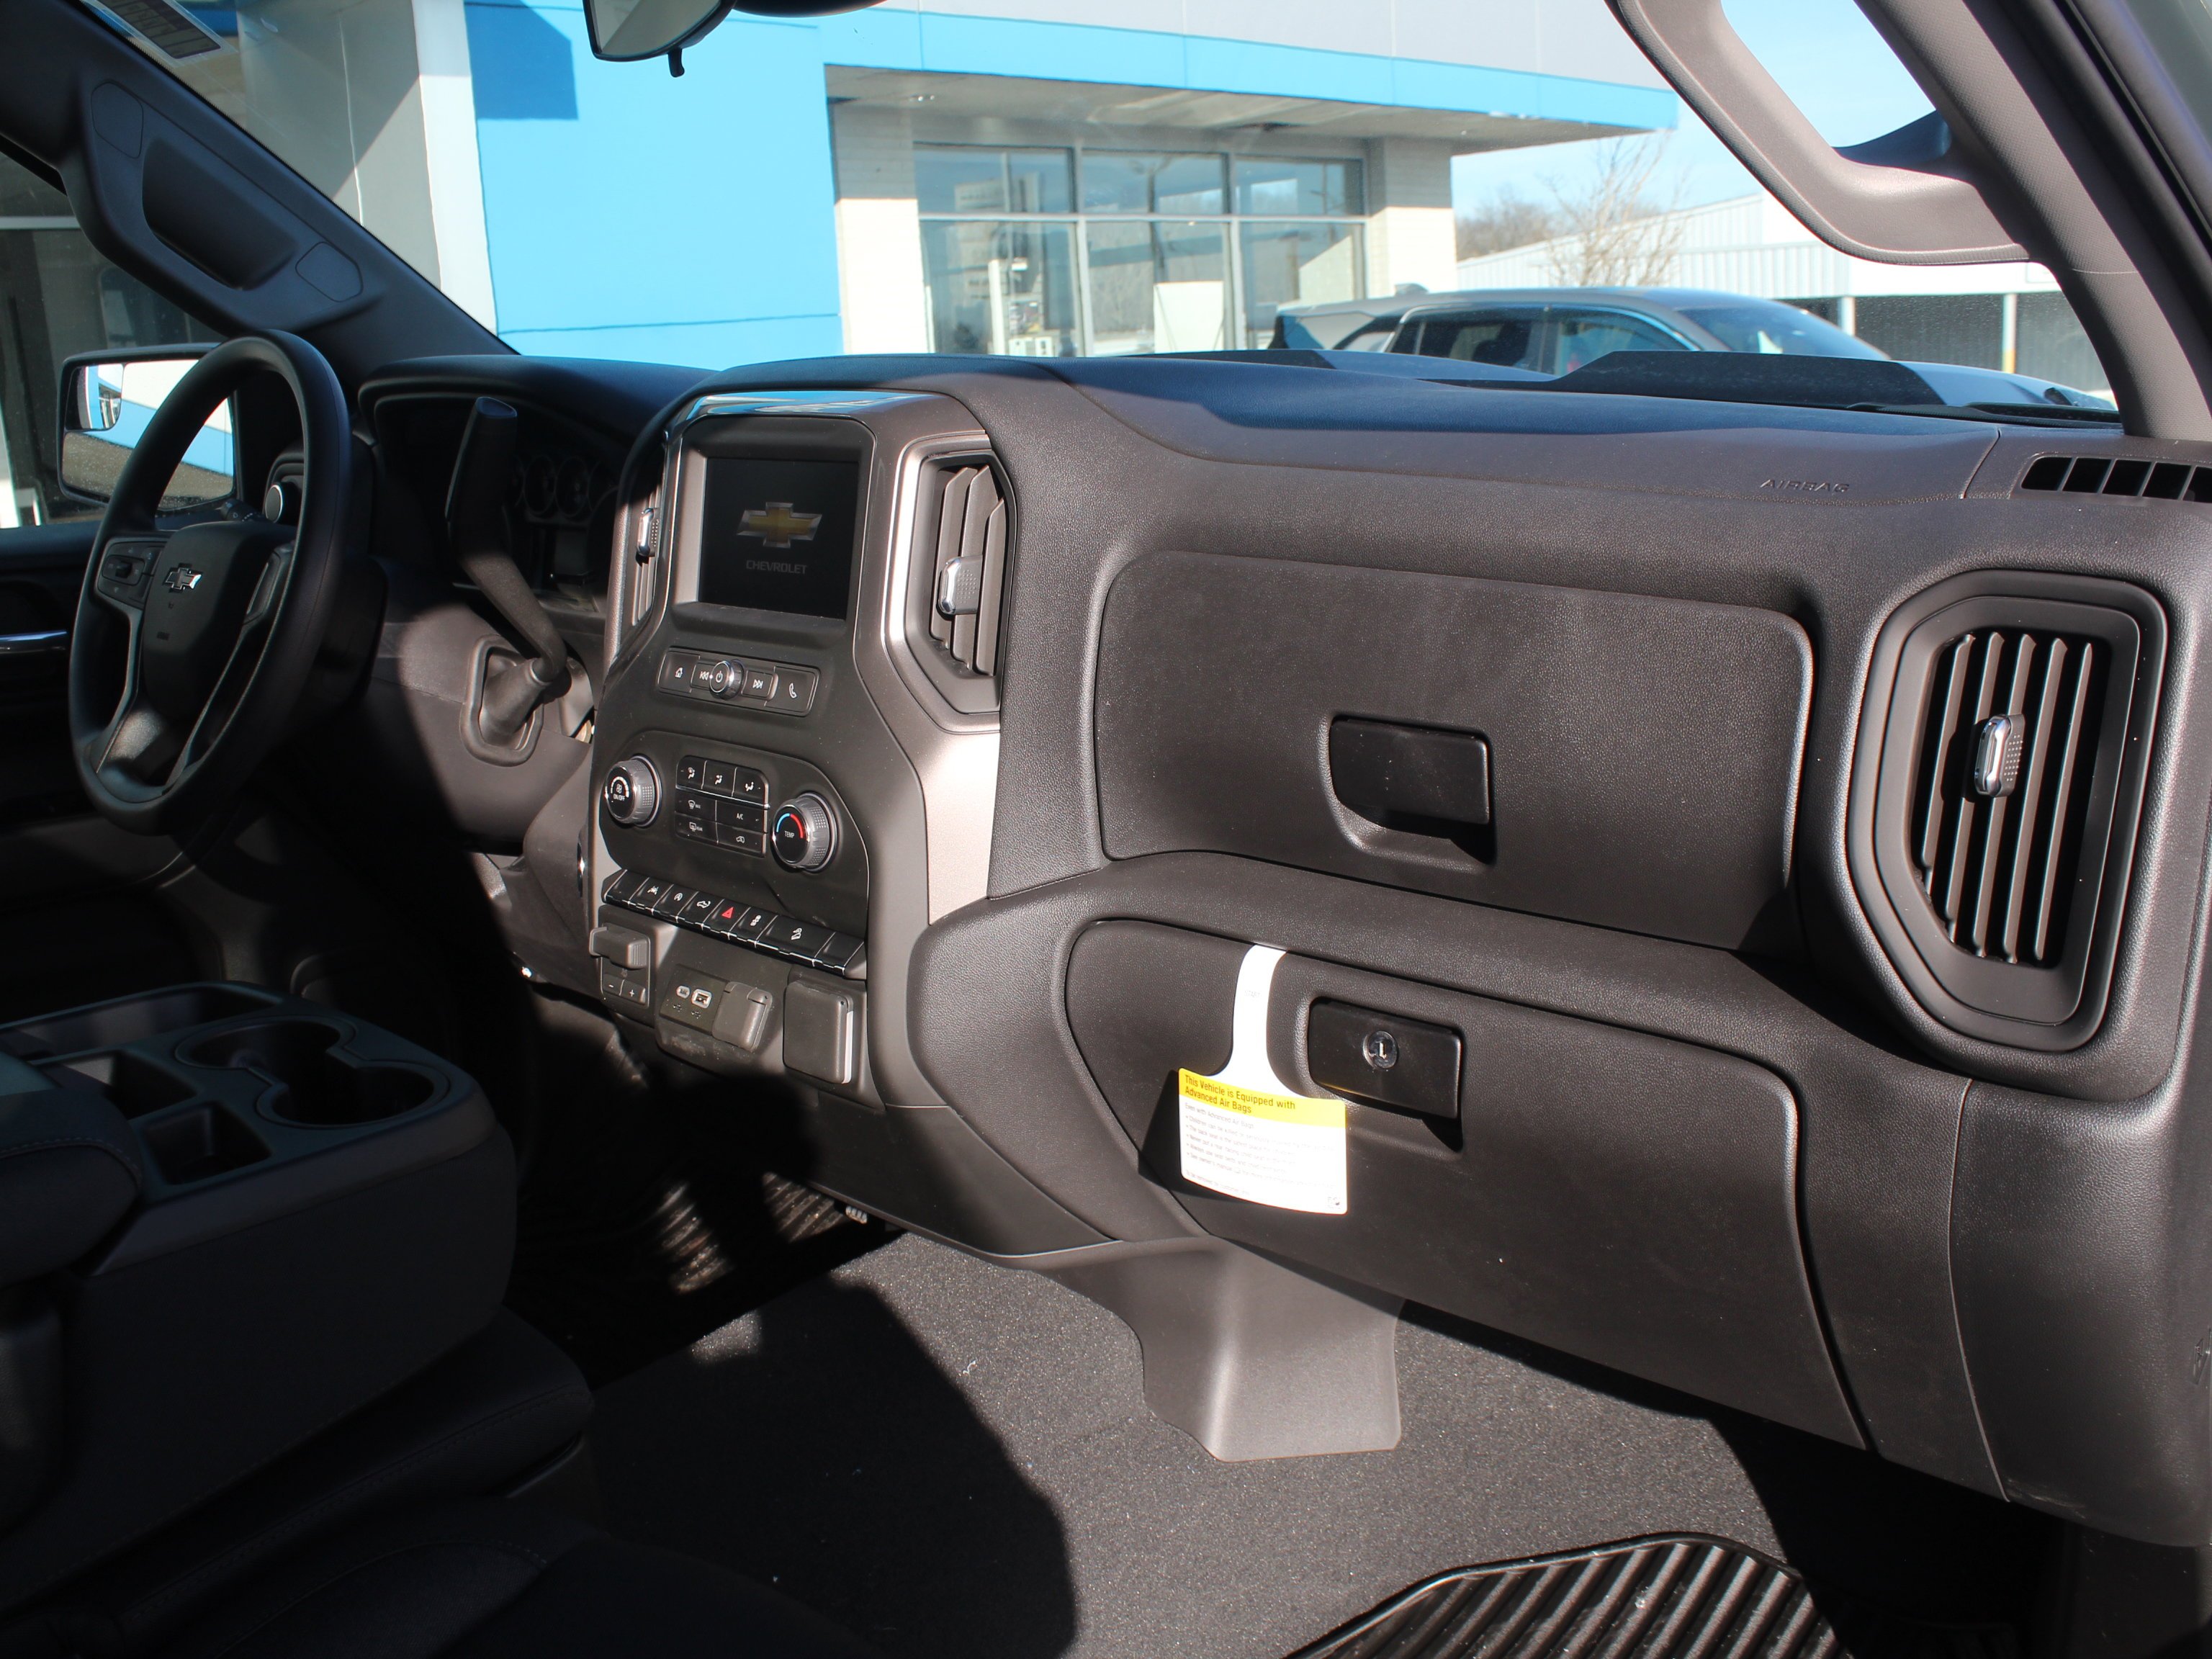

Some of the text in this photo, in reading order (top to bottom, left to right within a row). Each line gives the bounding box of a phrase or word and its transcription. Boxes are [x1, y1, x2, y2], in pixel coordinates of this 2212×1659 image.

[1760, 479, 1850, 493] AIRBAG
[746, 559, 807, 575] CHEVROLET
[784, 830, 795, 839] TEMP
[1184, 1074, 1296, 1110] This Vehicle is Equipped with
[1184, 1087, 1252, 1114] Advanced Air Bags
